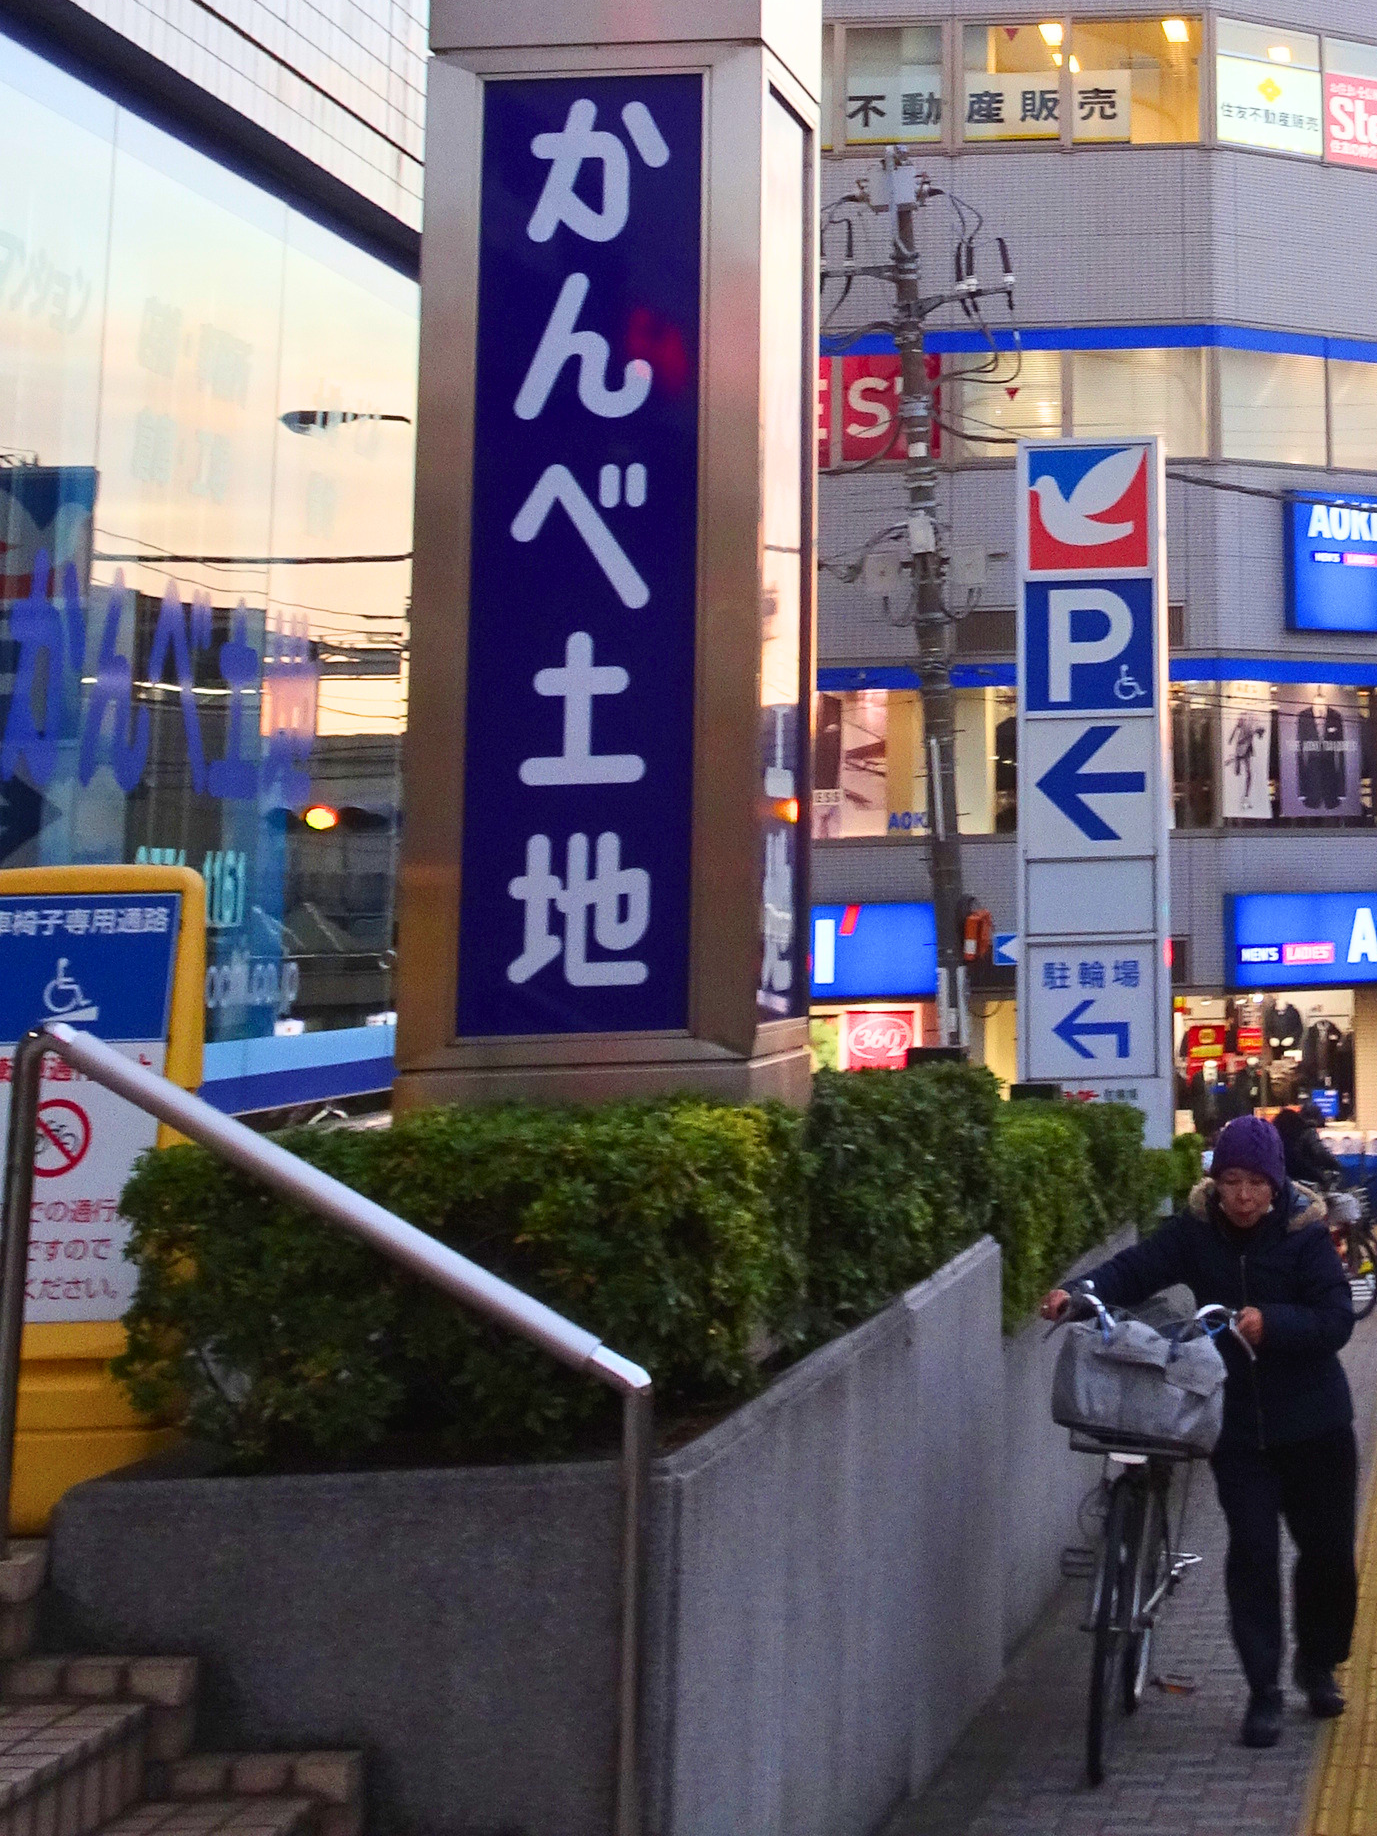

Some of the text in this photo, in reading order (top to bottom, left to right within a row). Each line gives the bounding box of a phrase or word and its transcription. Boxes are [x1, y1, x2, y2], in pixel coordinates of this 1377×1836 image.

[1220, 101, 1320, 133] 住友不動産販売
[507, 98, 671, 988] かんべ土地
[1048, 588, 1134, 703] P
[1241, 947, 1280, 962] MEN'S
[1042, 961, 1139, 990] 駐輪場
